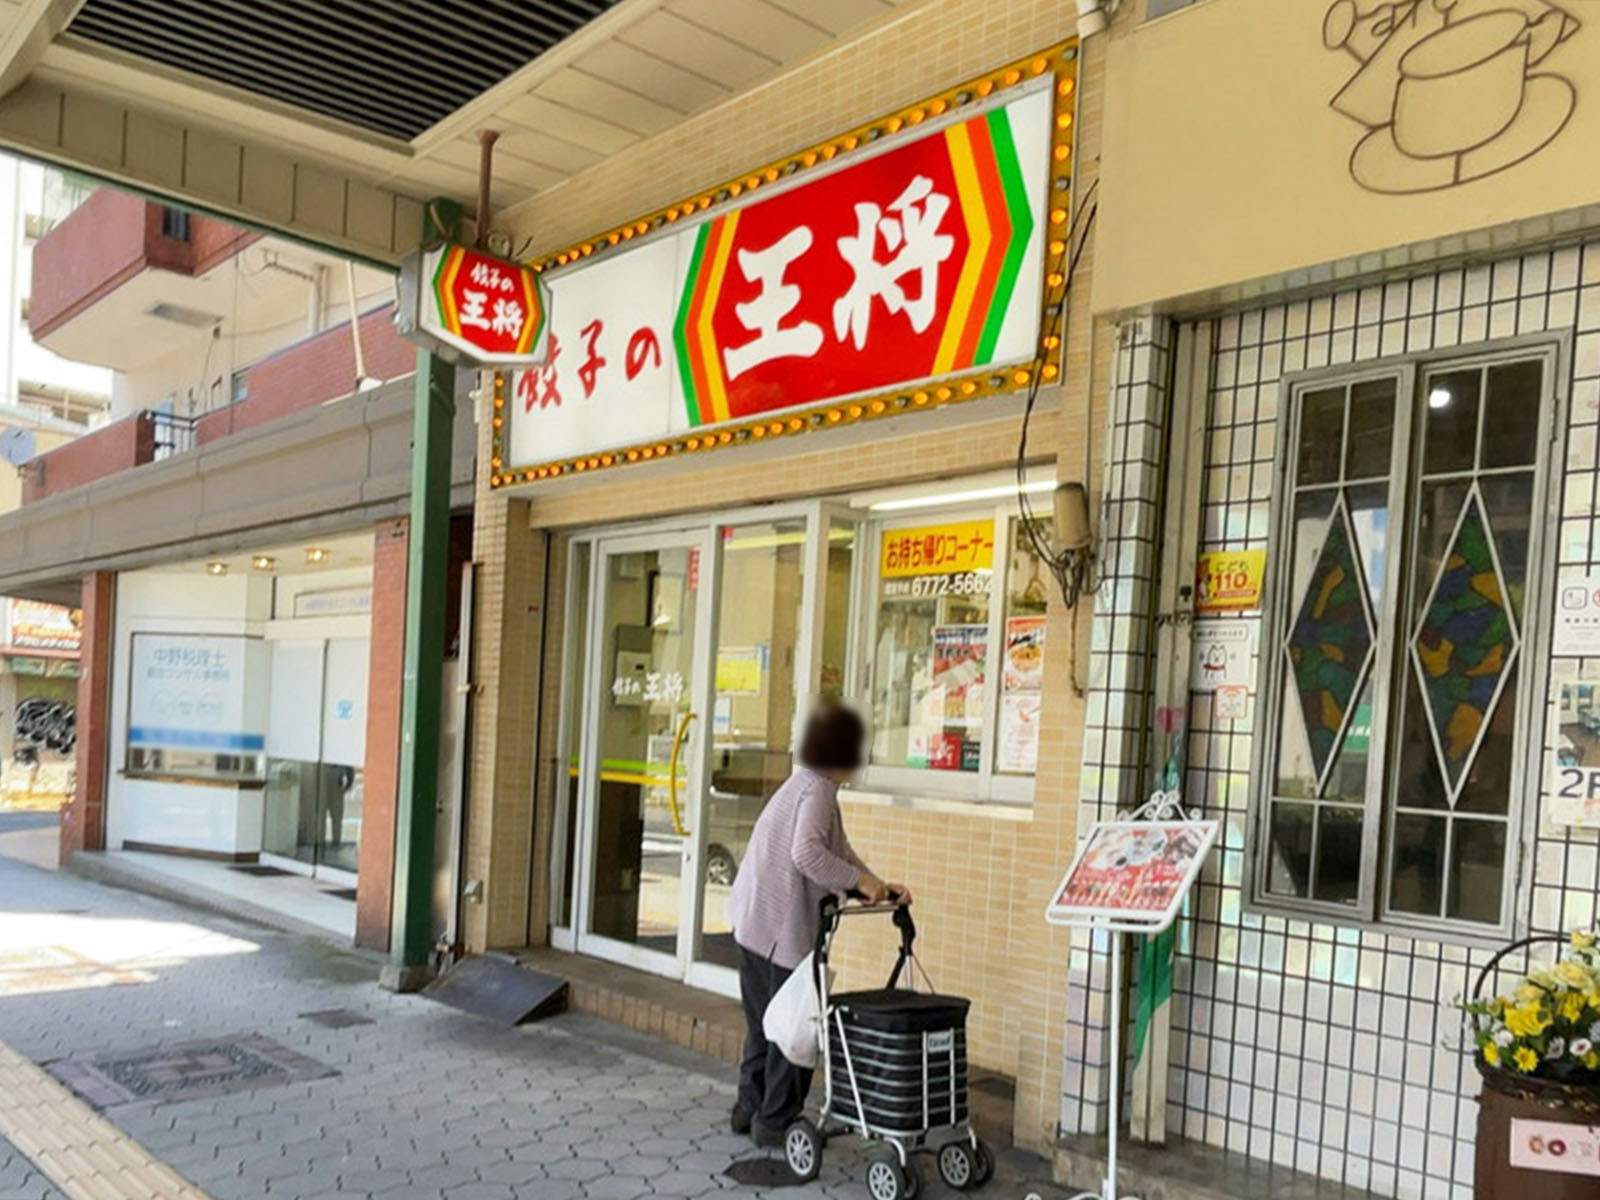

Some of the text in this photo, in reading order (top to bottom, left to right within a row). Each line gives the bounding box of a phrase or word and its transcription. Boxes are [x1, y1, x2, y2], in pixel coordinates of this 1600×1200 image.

[470, 261, 515, 293] 餃子の
[723, 174, 955, 382] 王将
[459, 287, 524, 341] 王将
[1213, 572, 1248, 591] 110
[643, 670, 684, 703] 王将
